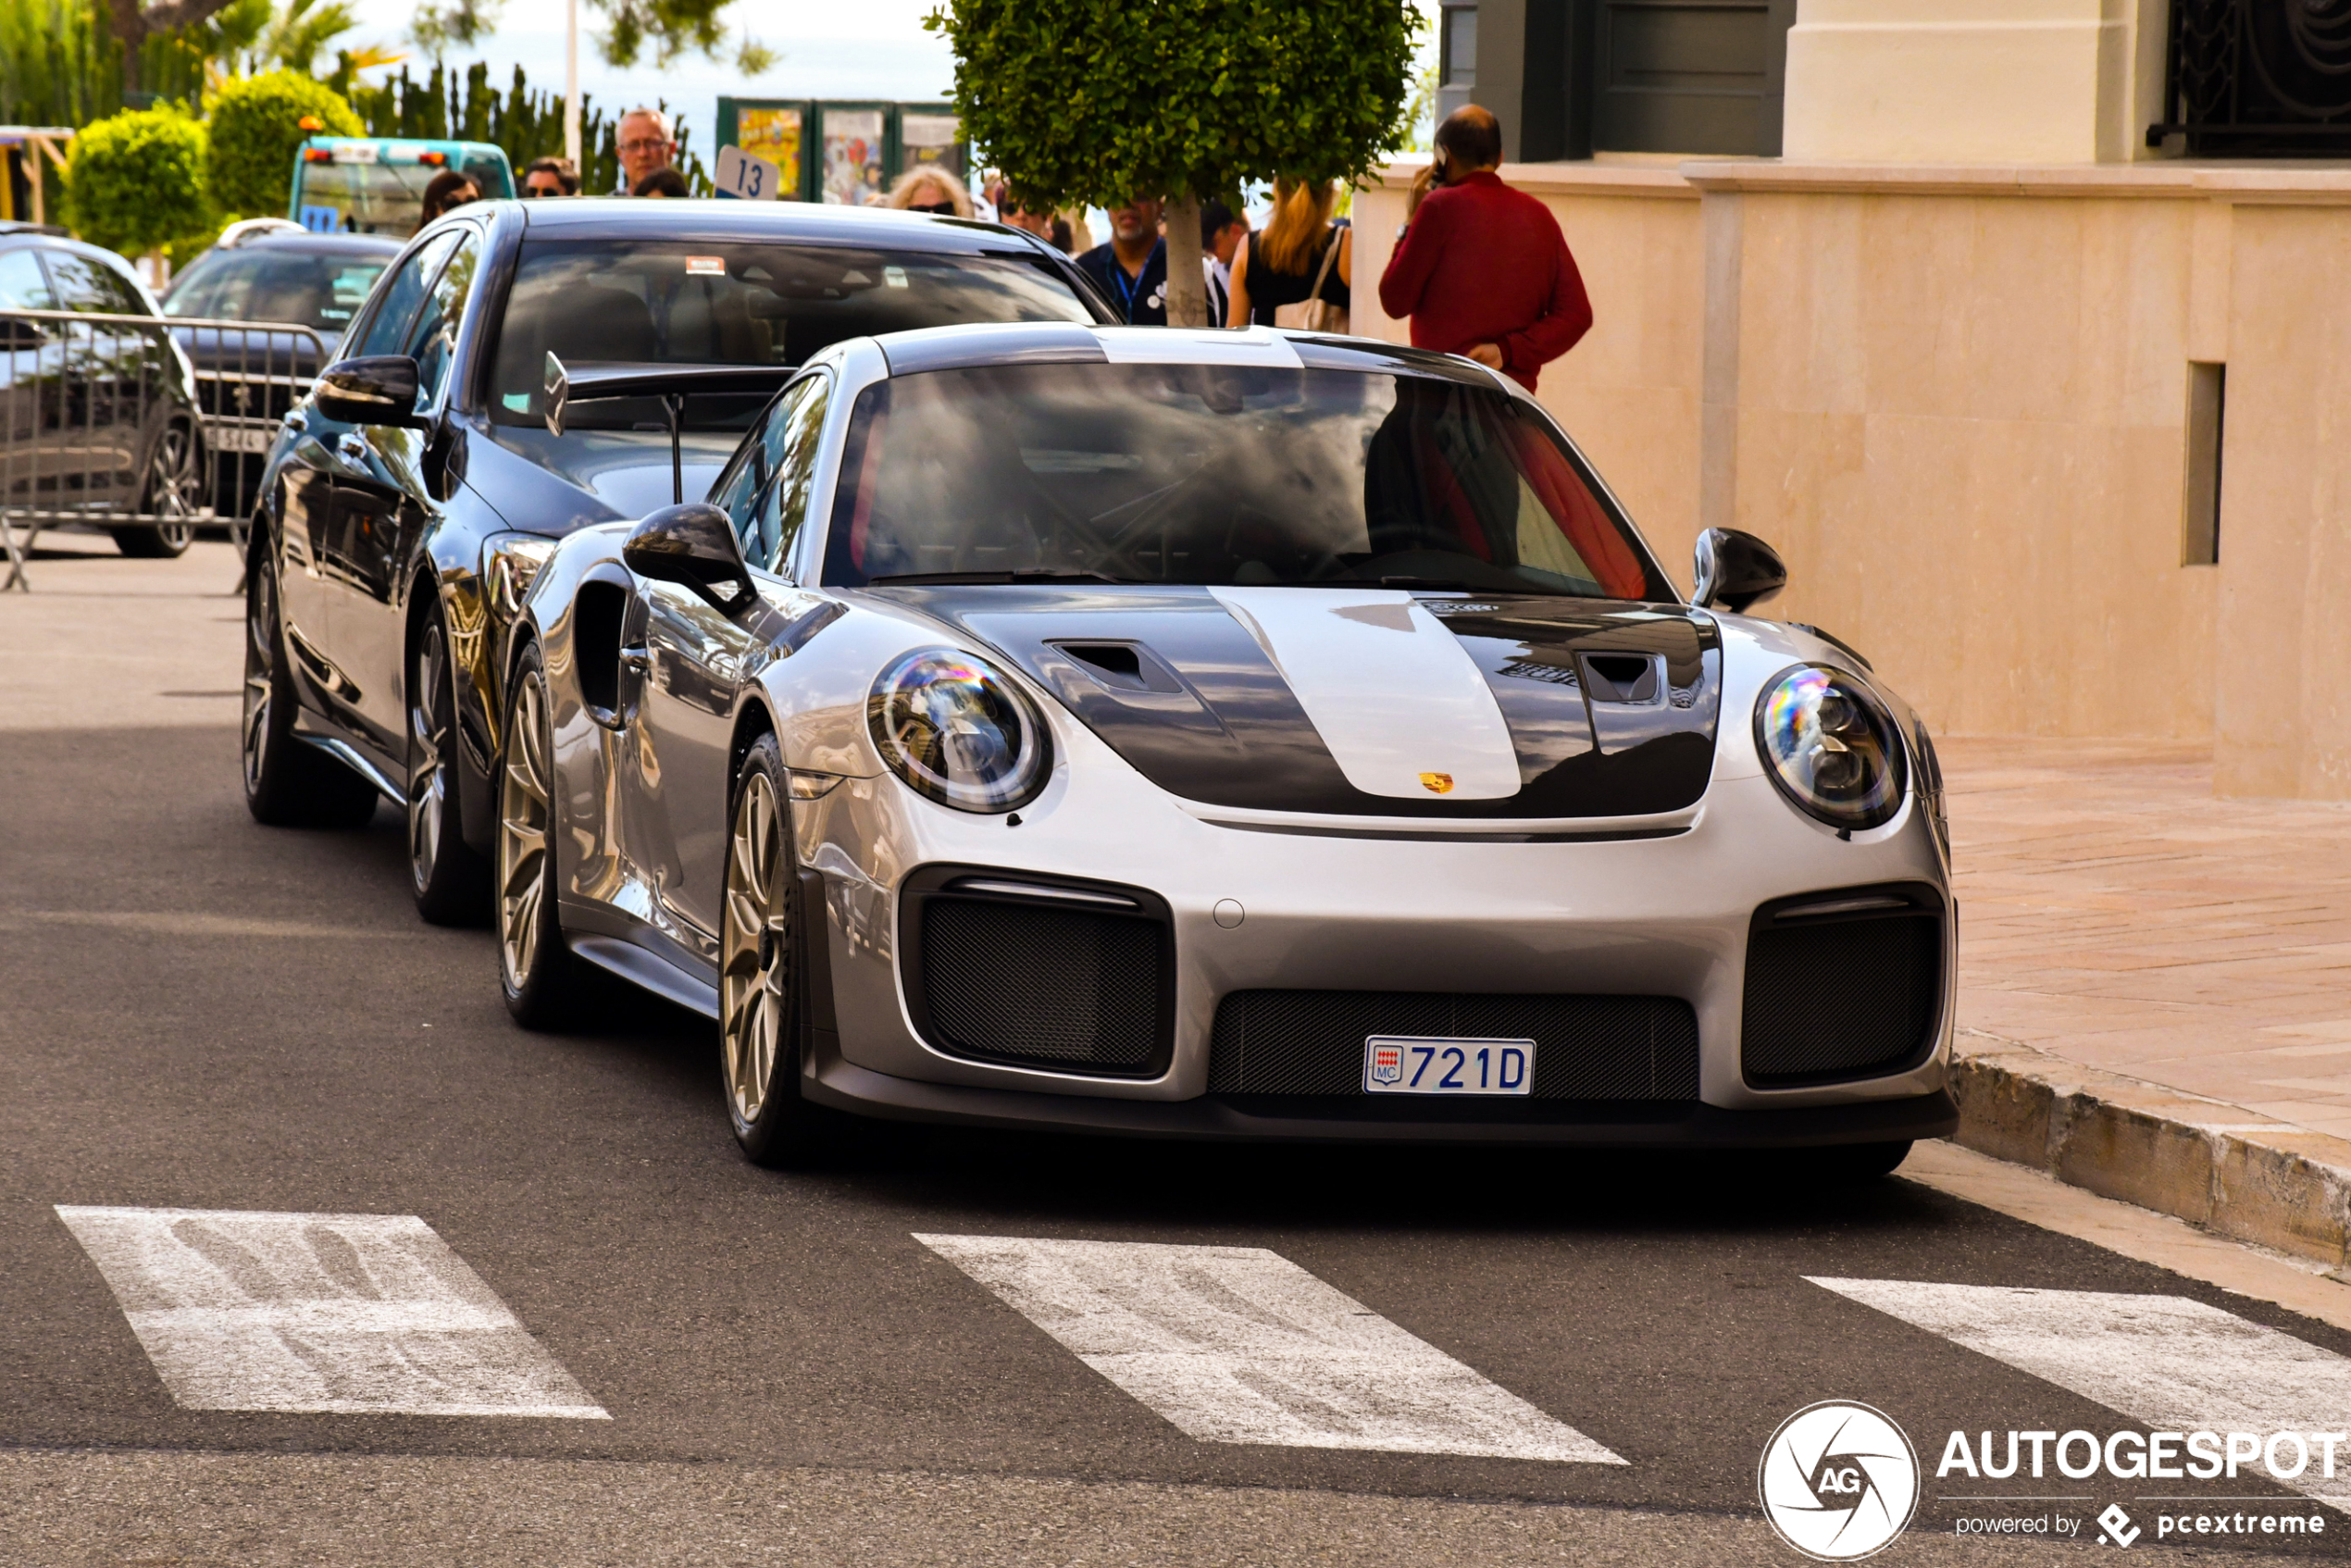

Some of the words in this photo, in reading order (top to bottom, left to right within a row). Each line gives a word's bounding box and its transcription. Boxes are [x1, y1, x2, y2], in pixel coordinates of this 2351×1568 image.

[739, 159, 763, 197] 13
[1377, 1067, 1396, 1078] MC
[1410, 1047, 1524, 1088] 721D
